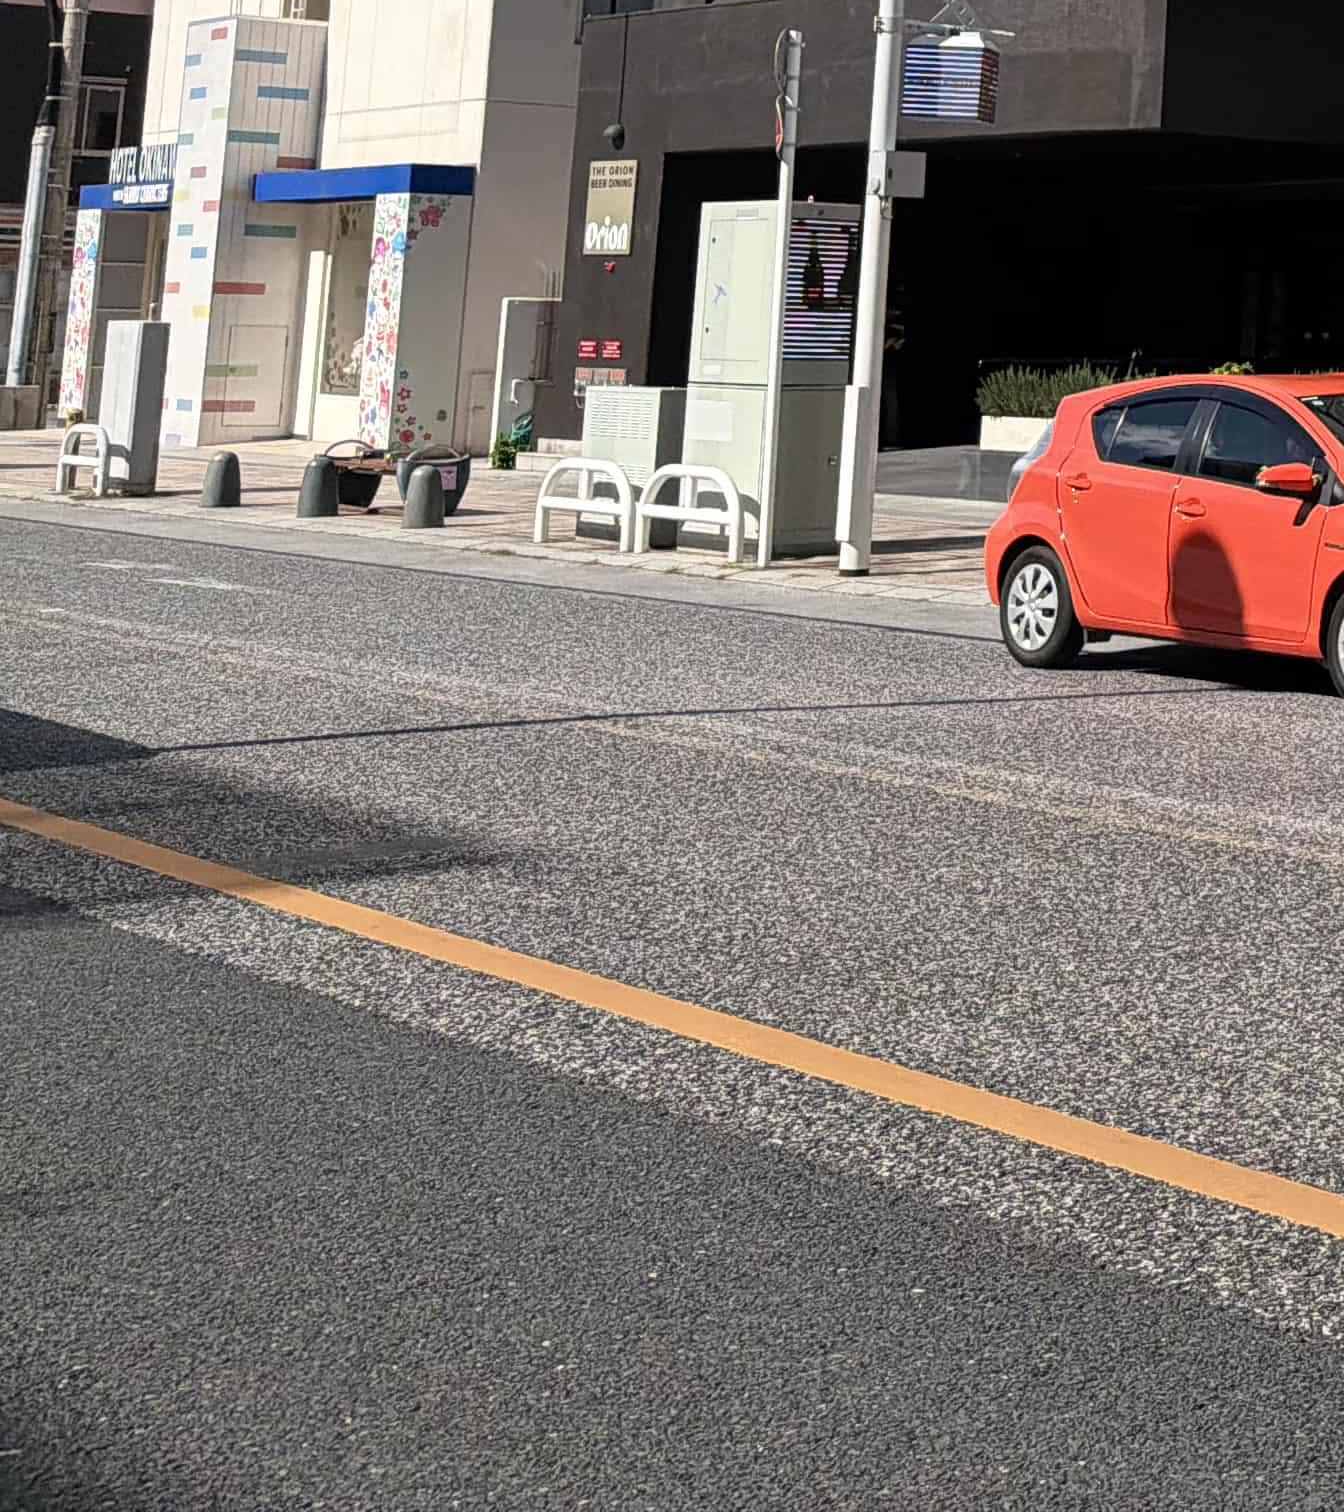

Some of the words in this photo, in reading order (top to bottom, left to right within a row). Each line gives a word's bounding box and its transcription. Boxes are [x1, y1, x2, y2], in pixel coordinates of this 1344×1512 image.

[109, 146, 137, 184] HOTEL
[592, 166, 607, 177] THE
[608, 165, 635, 177] ORION
[591, 178, 607, 188] BEER
[608, 176, 633, 188] DINING
[585, 215, 628, 250] Orion
